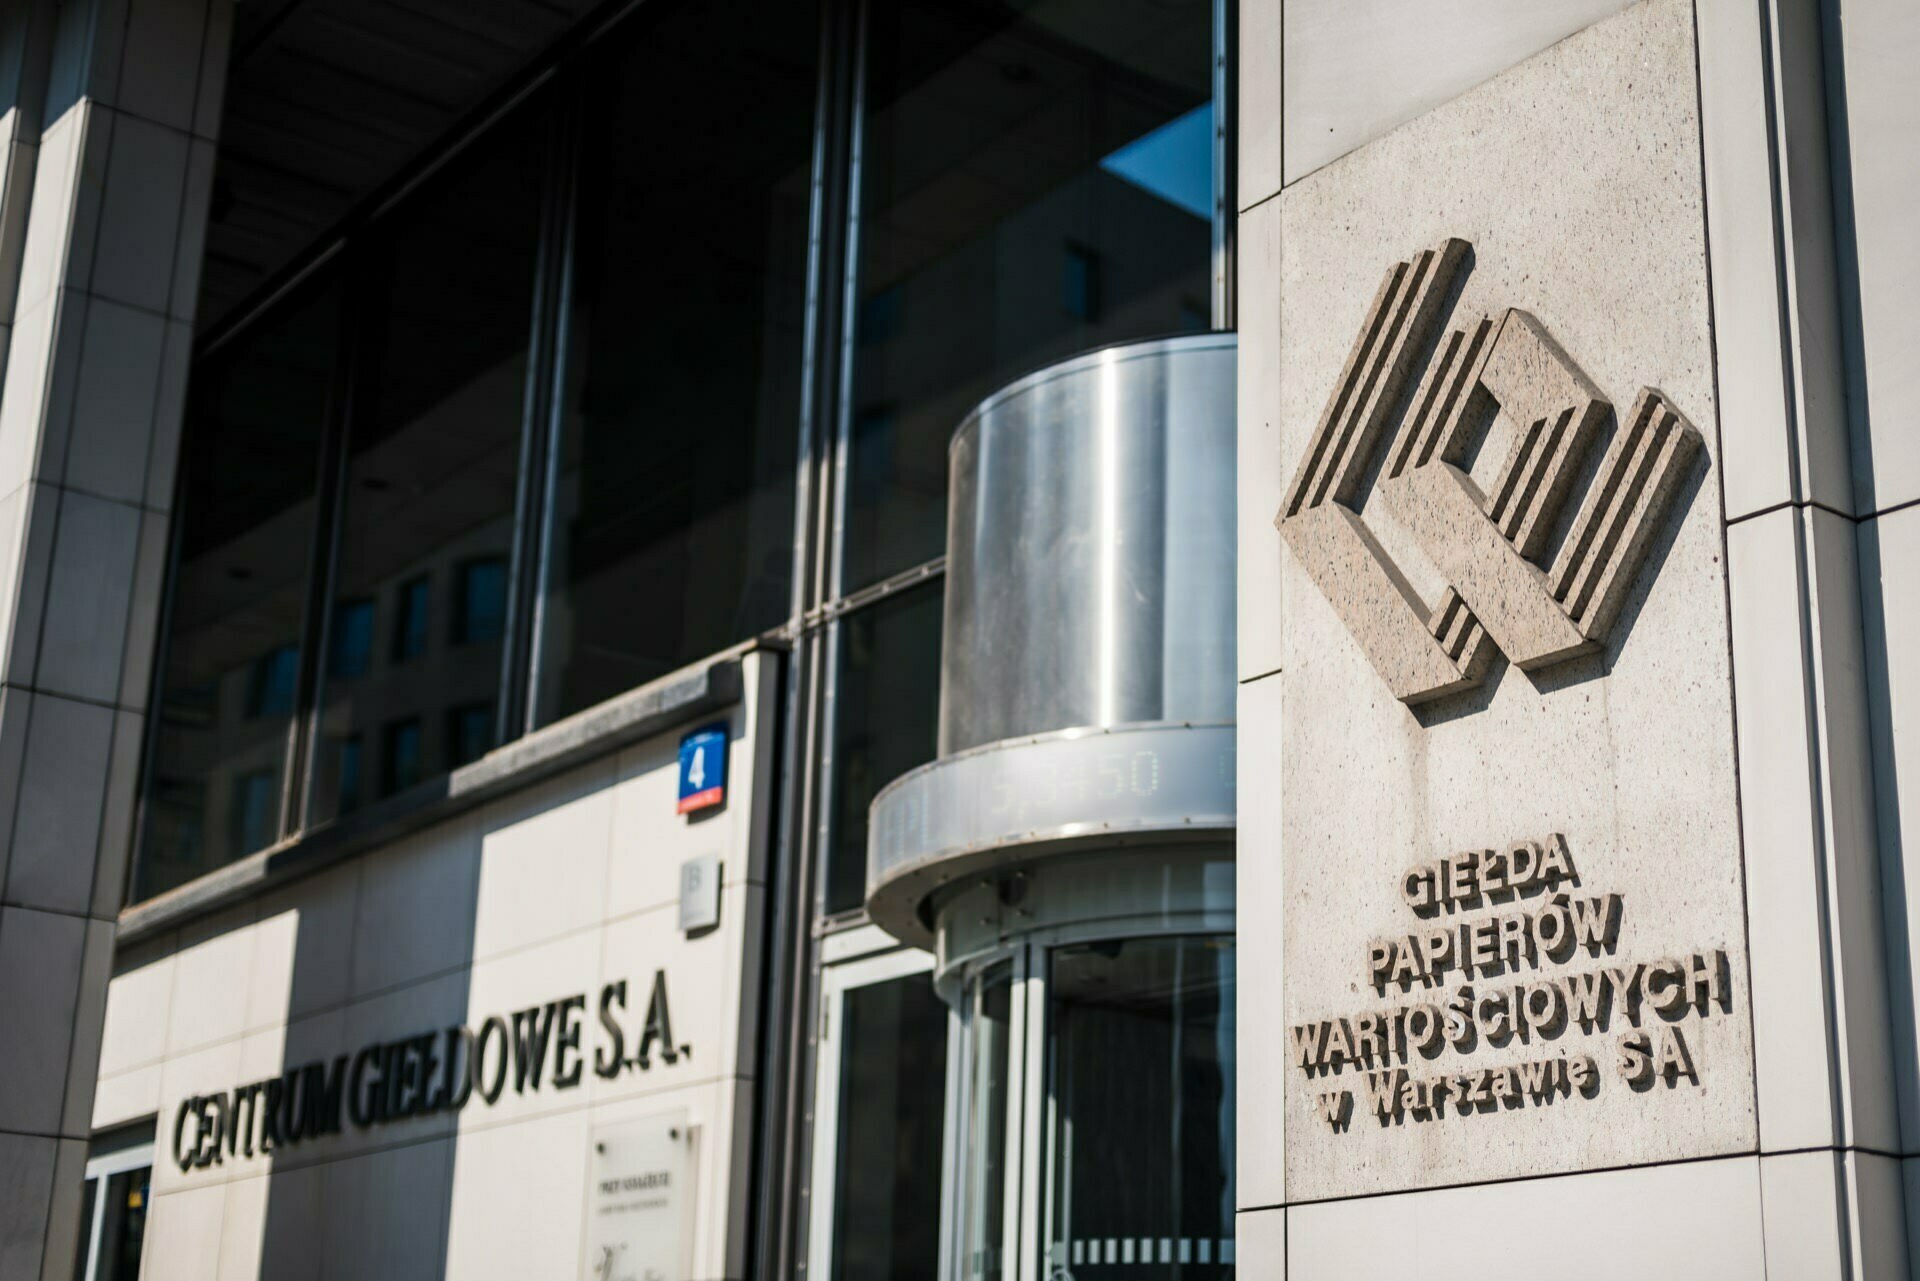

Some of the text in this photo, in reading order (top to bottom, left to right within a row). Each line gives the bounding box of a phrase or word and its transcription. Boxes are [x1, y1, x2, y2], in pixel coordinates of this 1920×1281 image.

[688, 746, 706, 789] 4
[1401, 833, 1575, 912] GIEŁDA
[1367, 889, 1618, 991] PAPIERÓW
[1290, 950, 1726, 1073] WARTOŚCIOWYCH
[173, 969, 691, 1173] CENTRUM GIEŁDOWE S.A.
[1317, 1026, 1695, 1127] w Warszawie SA
